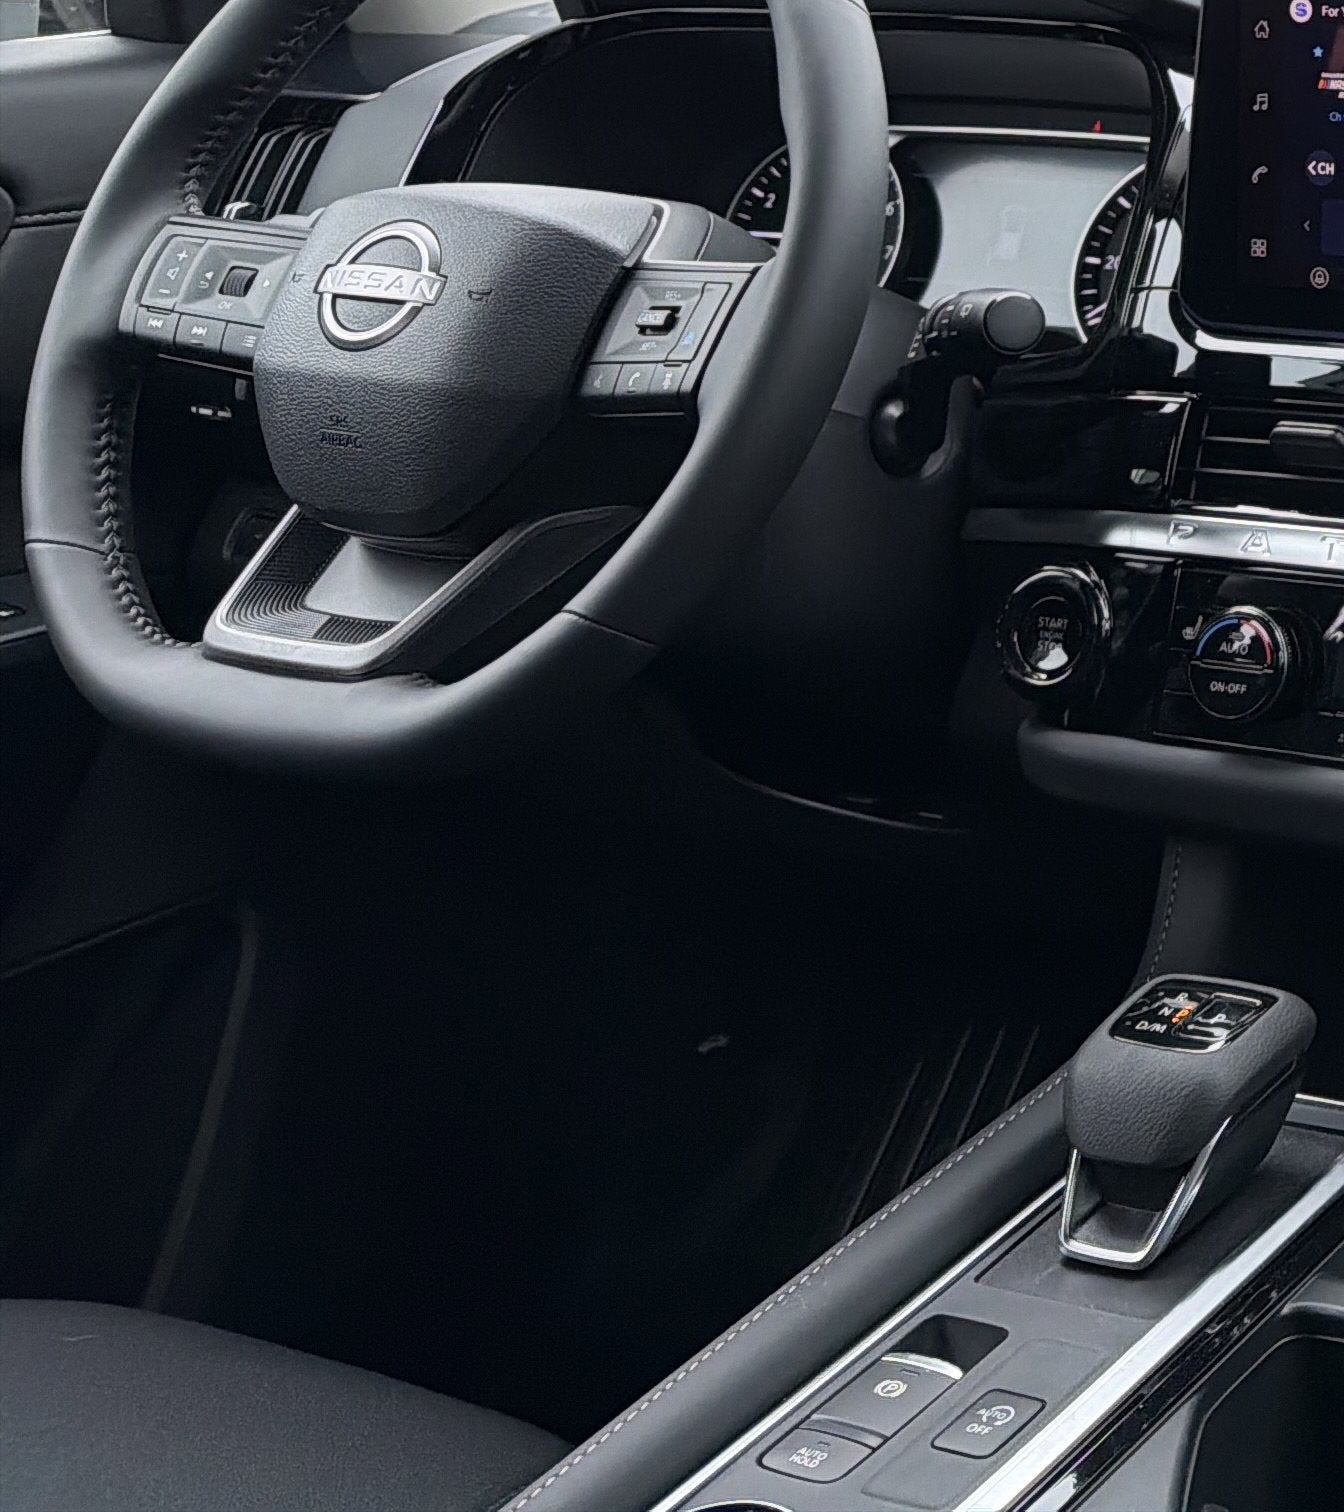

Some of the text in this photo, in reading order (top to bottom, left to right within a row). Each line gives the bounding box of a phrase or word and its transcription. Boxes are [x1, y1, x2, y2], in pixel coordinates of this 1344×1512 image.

[1321, 5, 1339, 18] For
[1329, 112, 1342, 123] Ch
[322, 268, 439, 301] NISSAN
[1038, 616, 1068, 630] START
[1219, 642, 1249, 655] AUTO
[1159, 1007, 1174, 1017] N
[1135, 1021, 1167, 1033] D/M
[976, 1407, 1006, 1423] AUTO
[966, 1423, 993, 1436] OFF
[797, 1445, 828, 1461] AUTO
[789, 1452, 820, 1469] HOLD
